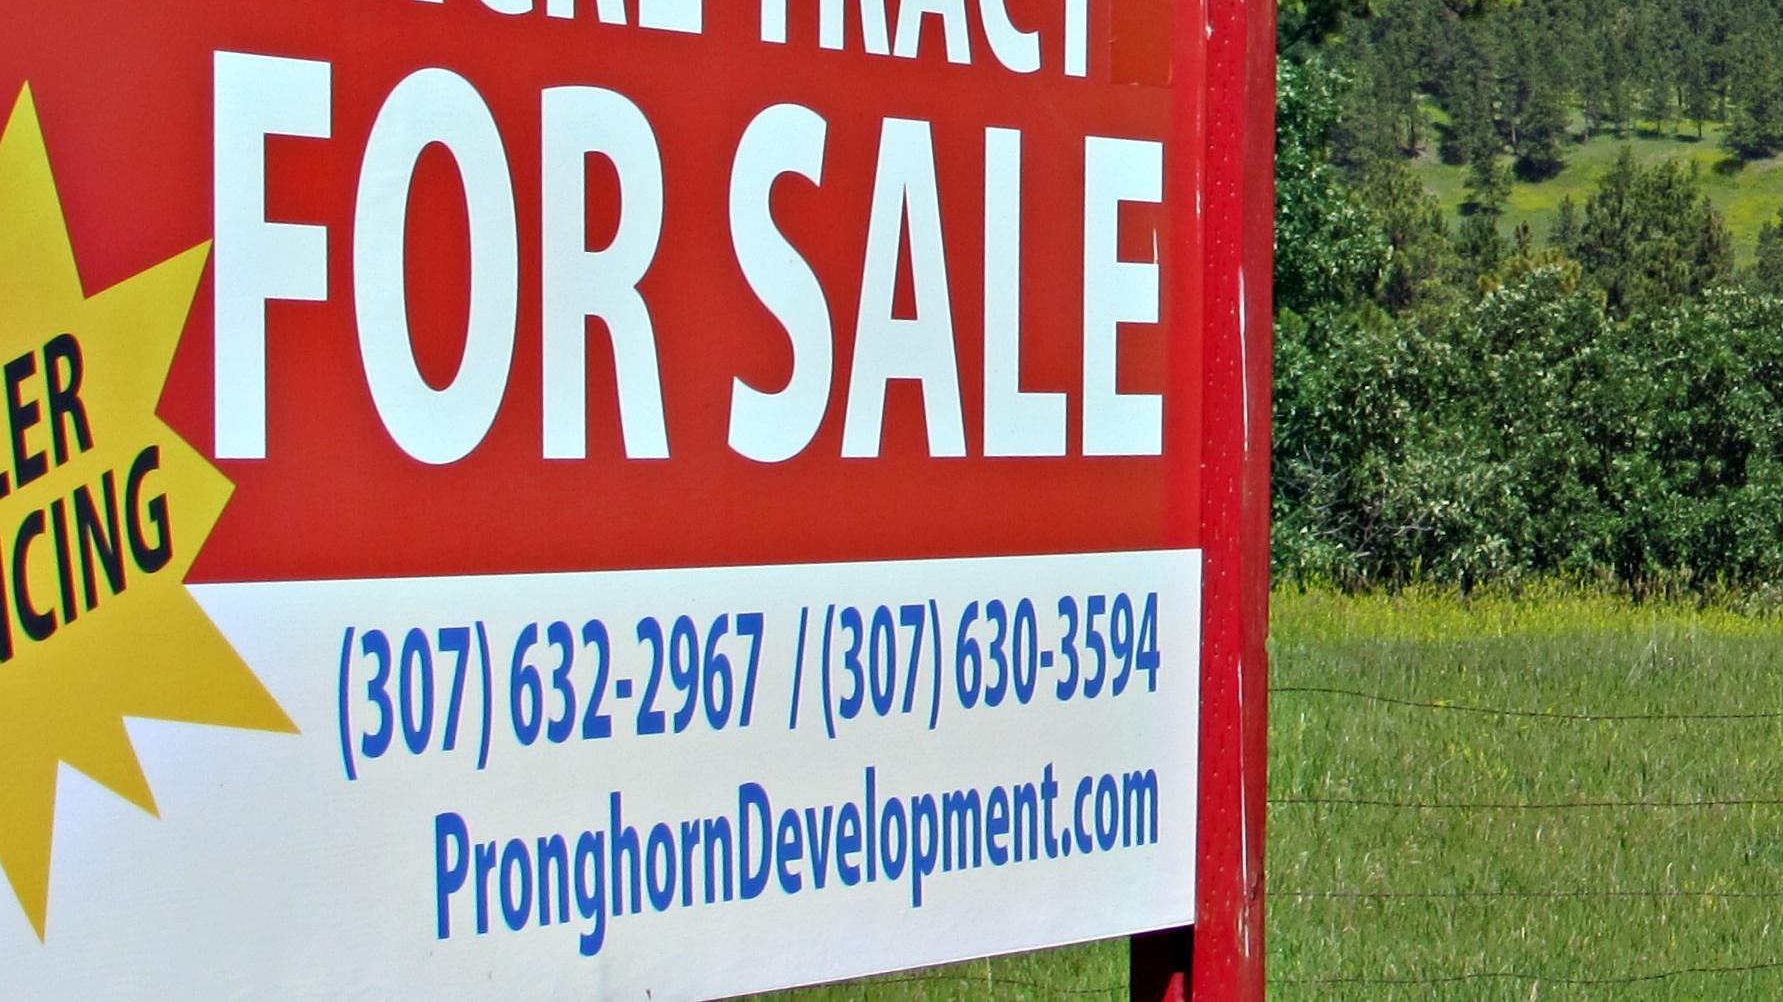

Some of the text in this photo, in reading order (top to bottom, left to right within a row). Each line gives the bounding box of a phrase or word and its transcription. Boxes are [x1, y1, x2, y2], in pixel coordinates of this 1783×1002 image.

[213, 50, 1163, 465] FOR SALE
[0, 333, 94, 499] ER
[338, 592, 1160, 781] (307) 632-2967 / (307) 630-3594
[434, 762, 1160, 956] PronghornDevelopment.com
